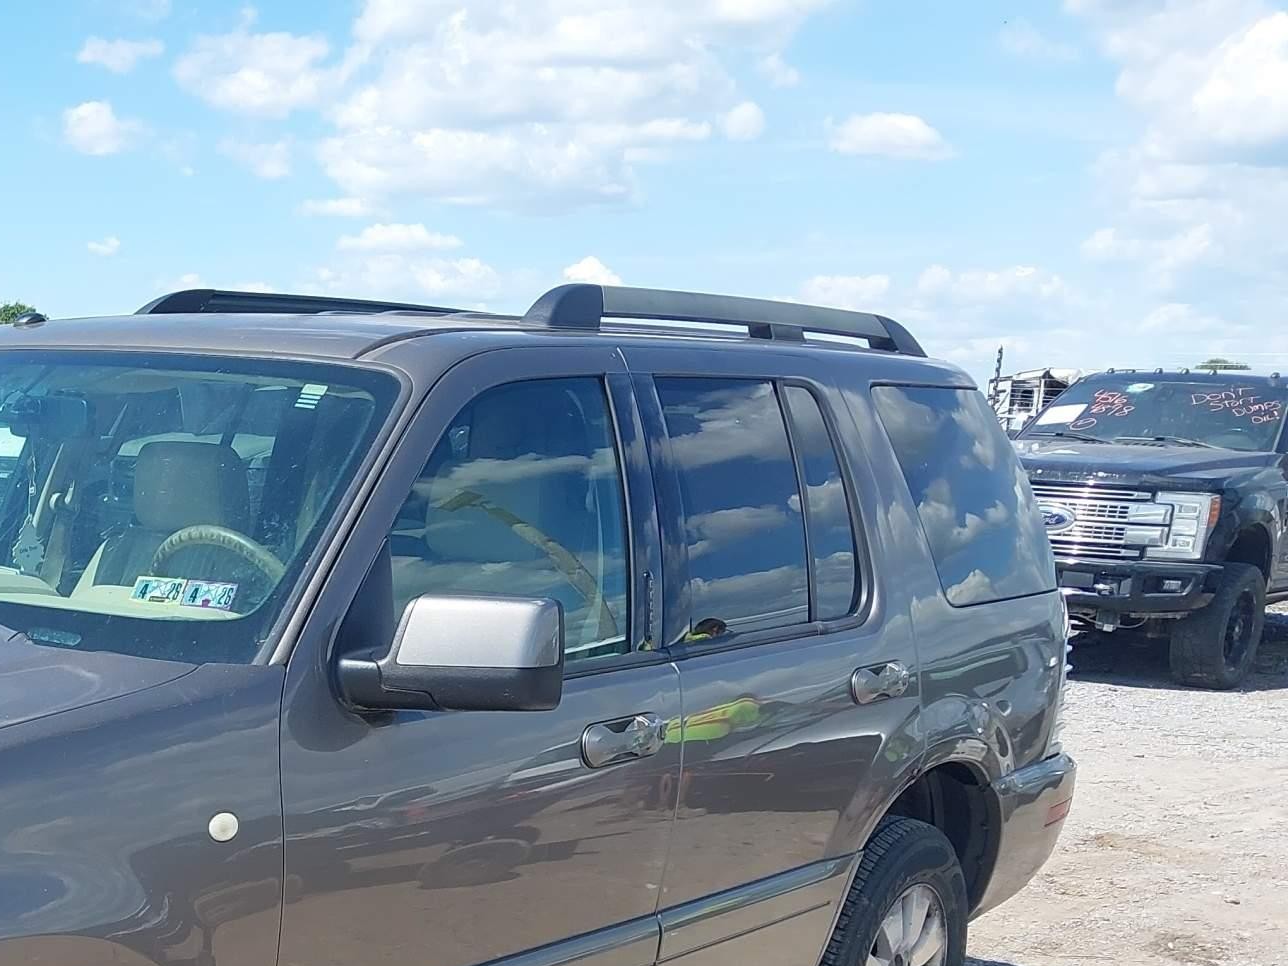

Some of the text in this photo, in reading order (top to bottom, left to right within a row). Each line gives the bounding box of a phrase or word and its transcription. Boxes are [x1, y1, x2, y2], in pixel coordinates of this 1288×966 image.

[138, 583, 149, 599] 4
[188, 586, 234, 605] 4 26
